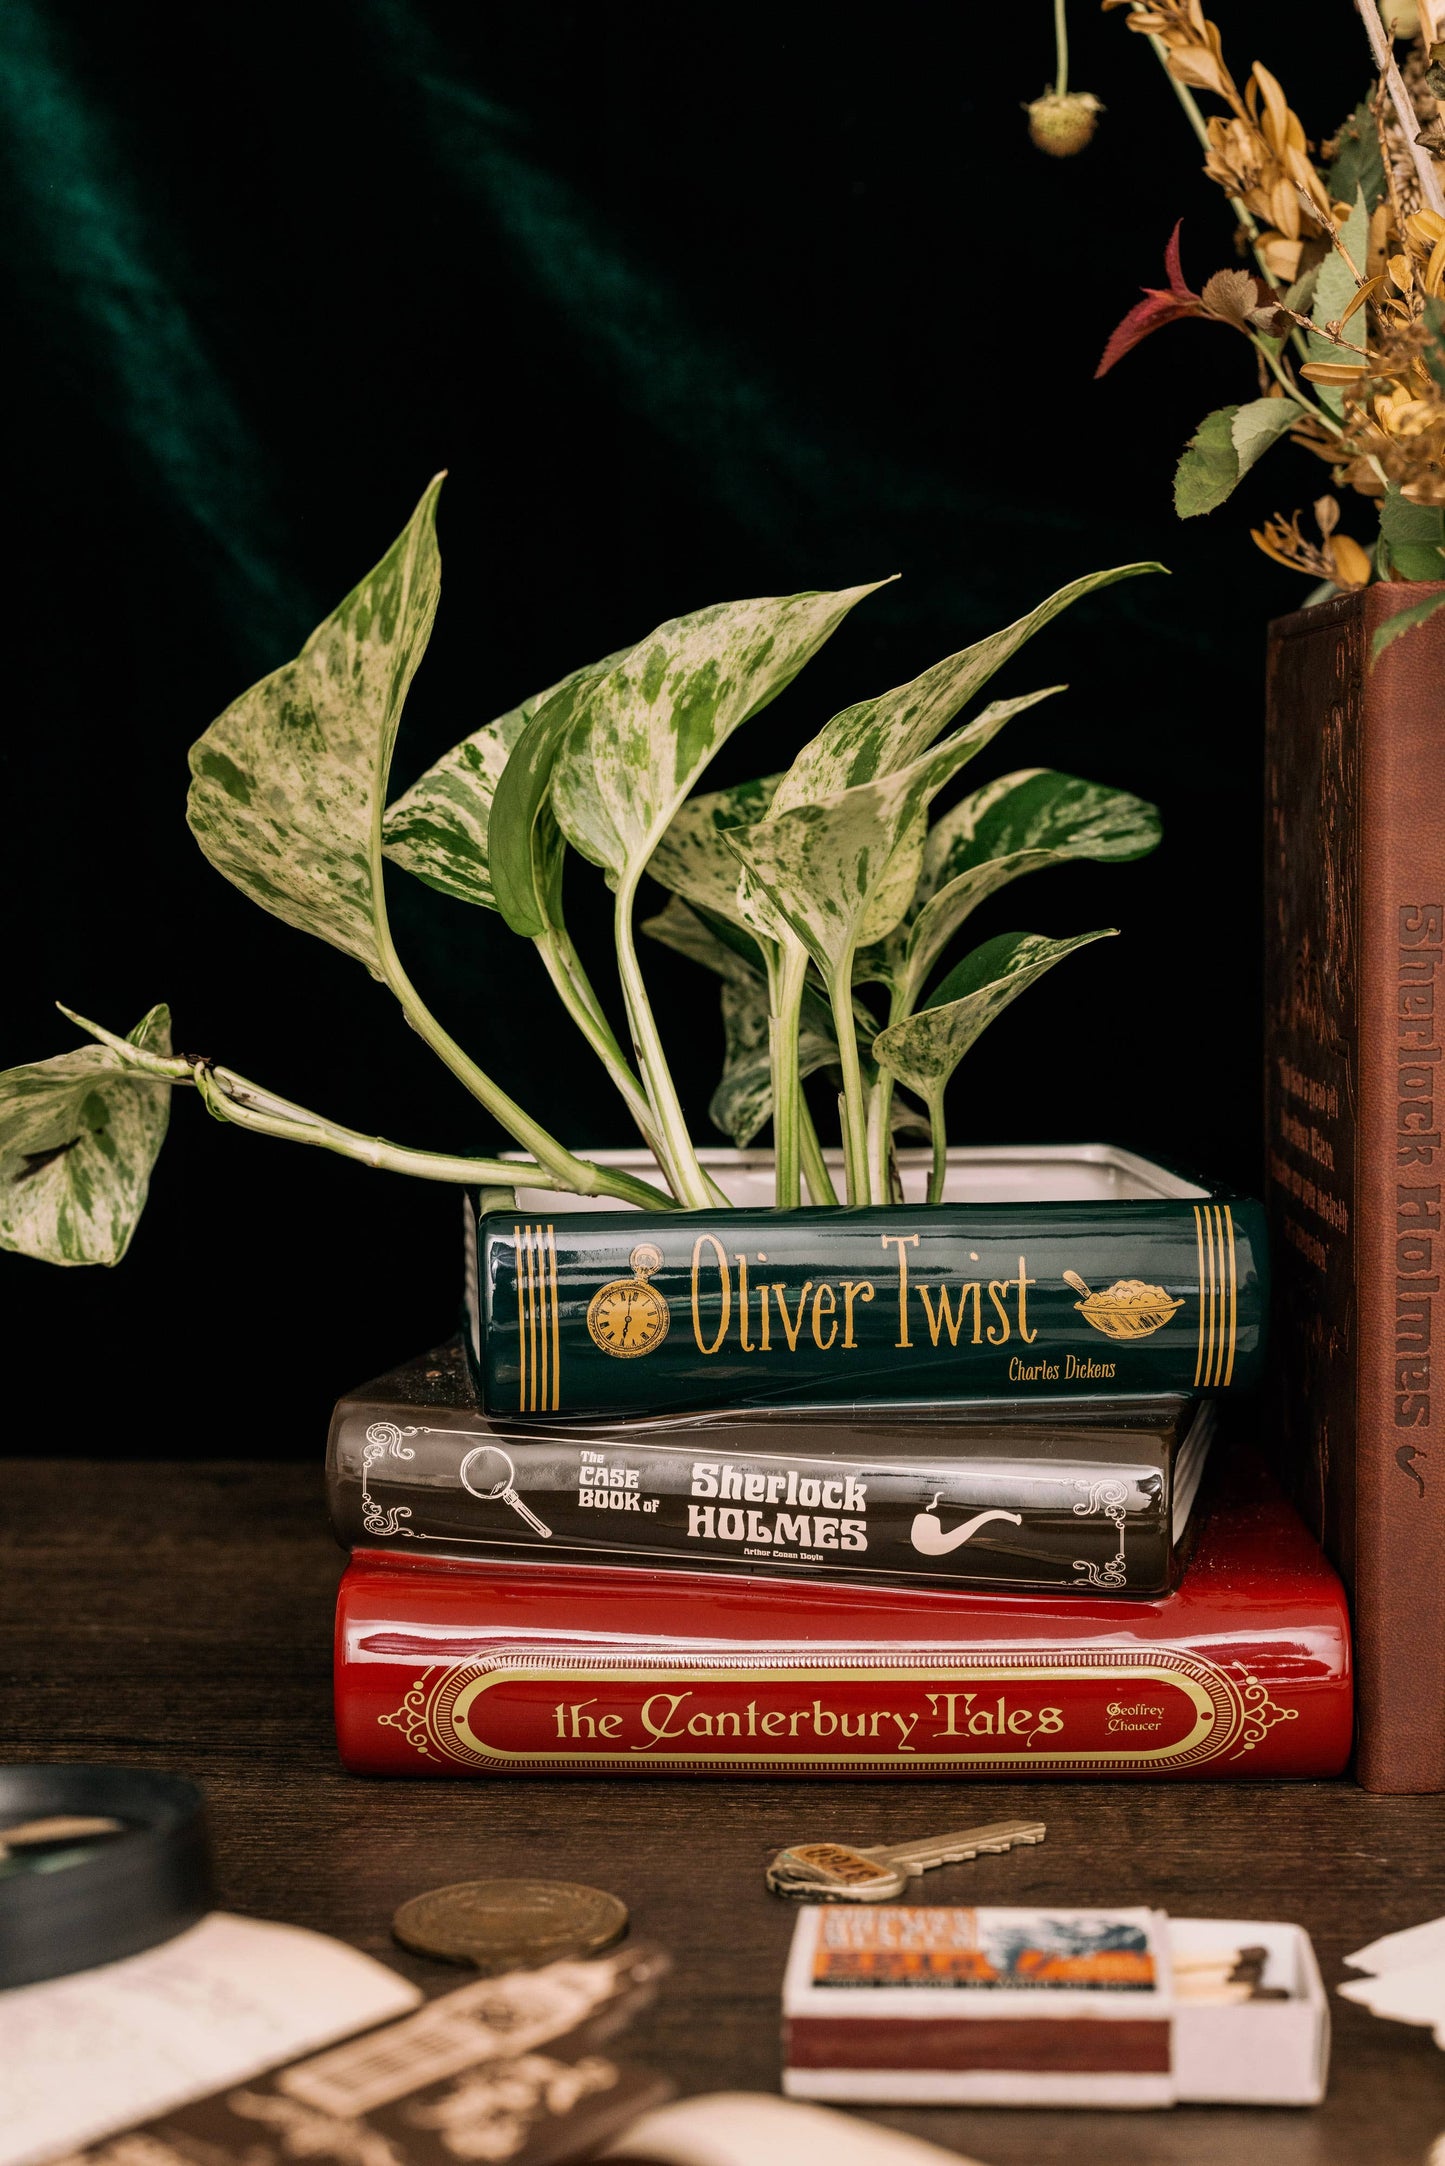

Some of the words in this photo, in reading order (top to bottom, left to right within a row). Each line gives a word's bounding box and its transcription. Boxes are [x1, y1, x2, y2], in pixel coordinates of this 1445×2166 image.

[1398, 904, 1443, 1167] Sherlock
[691, 1232, 874, 1355] Oliver
[880, 1233, 1038, 1348] Twist
[1395, 1183, 1441, 1428] Holmes
[1009, 1356, 1060, 1381] Charles
[1064, 1354, 1116, 1380] Dickens
[580, 1450, 605, 1464] The
[579, 1465, 640, 1489] CASE
[691, 1462, 868, 1512] Sherlock
[578, 1488, 641, 1512] BOOK
[687, 1504, 869, 1551] HOLMES
[743, 1547, 771, 1557] Arthur
[772, 1550, 798, 1559] Conan
[799, 1552, 824, 1561] Doyle
[552, 1698, 623, 1739] the
[630, 1691, 919, 1751] Canterbury
[925, 1693, 1064, 1747] Tales
[1106, 1702, 1164, 1719] Geoffrey
[1105, 1718, 1162, 1735] Chaucer
